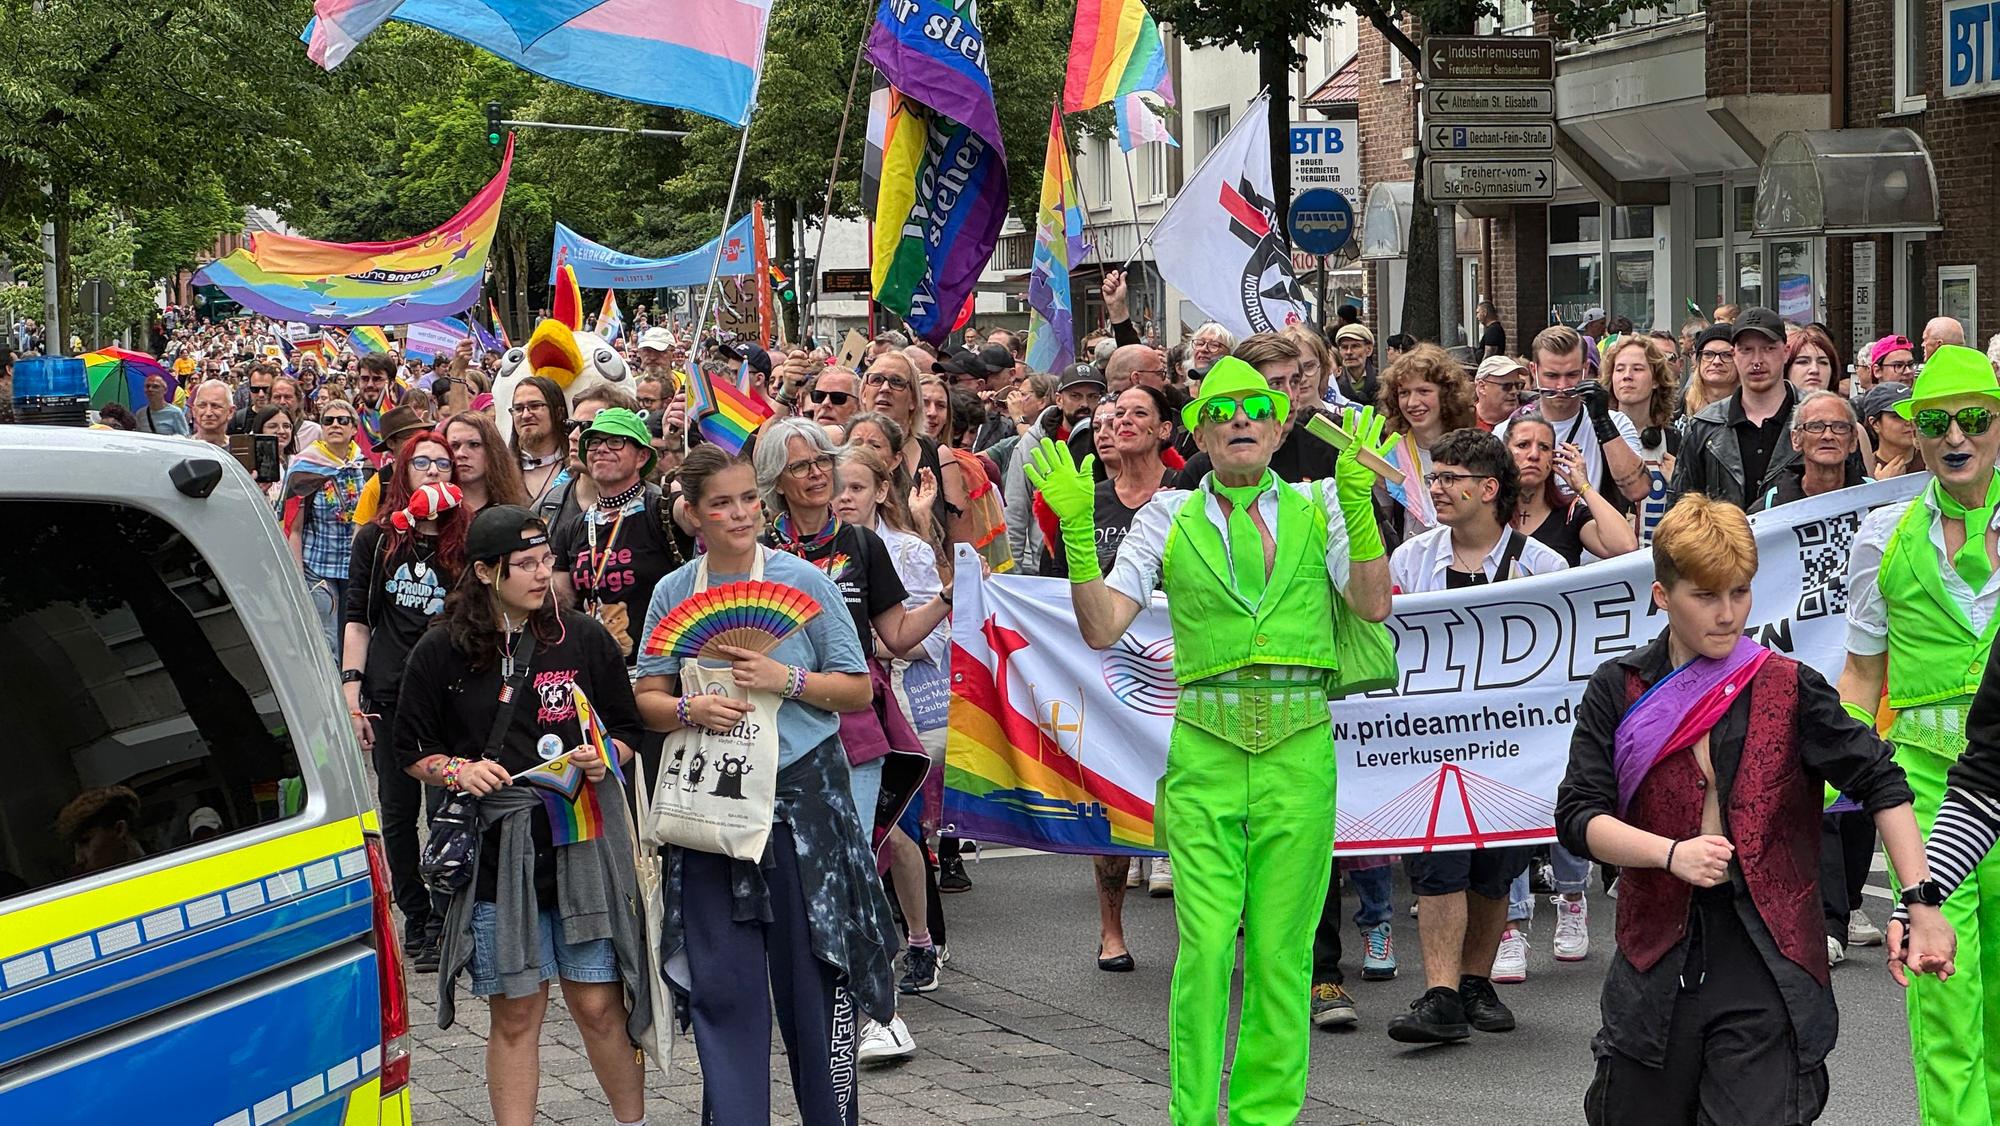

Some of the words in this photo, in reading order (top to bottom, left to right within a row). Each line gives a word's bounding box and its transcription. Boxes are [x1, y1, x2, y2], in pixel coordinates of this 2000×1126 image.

[1448, 44, 1540, 60] Industriemuseum
[1452, 95, 1489, 108] Altenheim
[1491, 95, 1501, 108] St.
[1505, 95, 1538, 108] Elisabeth
[1289, 127, 1344, 154] BTB
[1455, 131, 1464, 145] P
[1469, 131, 1547, 144] Dechant-Fein-Straße
[1300, 158, 1323, 166] BAUEN
[1300, 166, 1339, 174] VERMIETEN
[1300, 174, 1341, 182] VERWALTEN
[1460, 166, 1532, 178] Freiherr-vom-
[1444, 181, 1532, 195] Stein-Gymnasium
[1292, 254, 1331, 270] KIOK
[725, 306, 760, 325] Schl
[576, 548, 632, 569] Free
[397, 581, 433, 597] PROUD
[395, 593, 429, 609] PUPPY
[533, 670, 579, 689] BREAK
[914, 694, 931, 704] aus
[1356, 740, 1520, 767] LeverkusenPride
